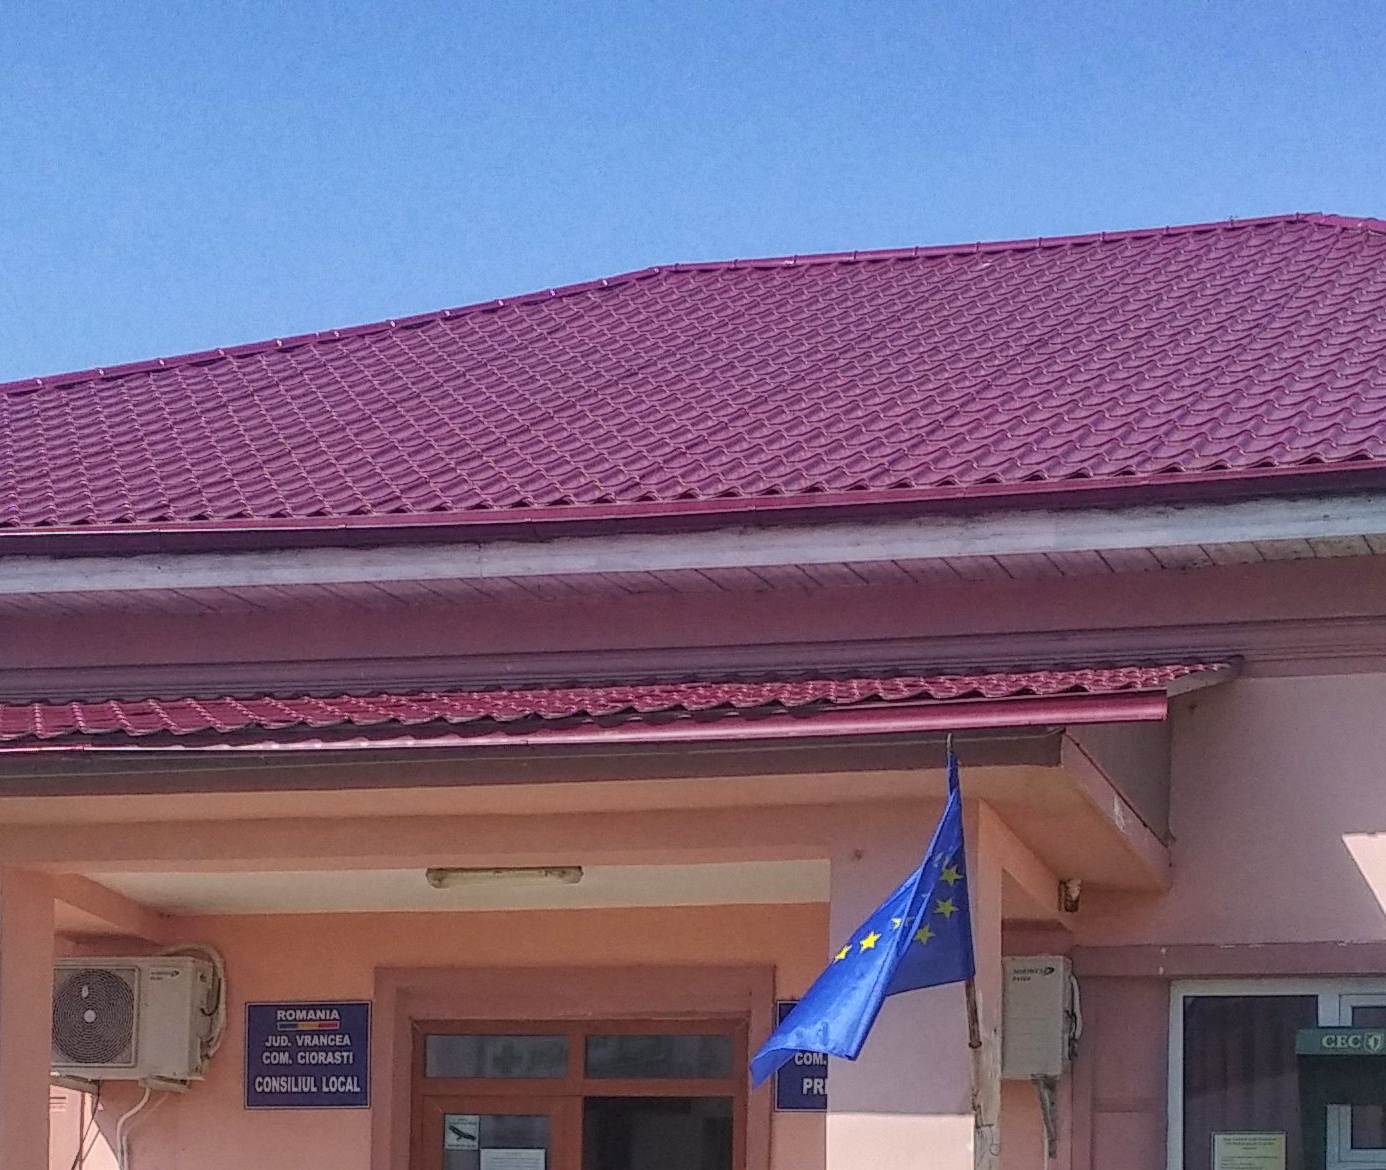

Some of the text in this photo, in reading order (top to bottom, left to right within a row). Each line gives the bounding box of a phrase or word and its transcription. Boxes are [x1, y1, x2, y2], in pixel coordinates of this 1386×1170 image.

[277, 1009, 340, 1021] ROMANIA
[265, 1034, 351, 1047] JUD. VRANCEA
[1321, 1035, 1361, 1049] CEC
[263, 1051, 353, 1065] COM. CIORASTI
[794, 1052, 827, 1066] COM.
[254, 1076, 361, 1093] CONSILIUL LOCAL
